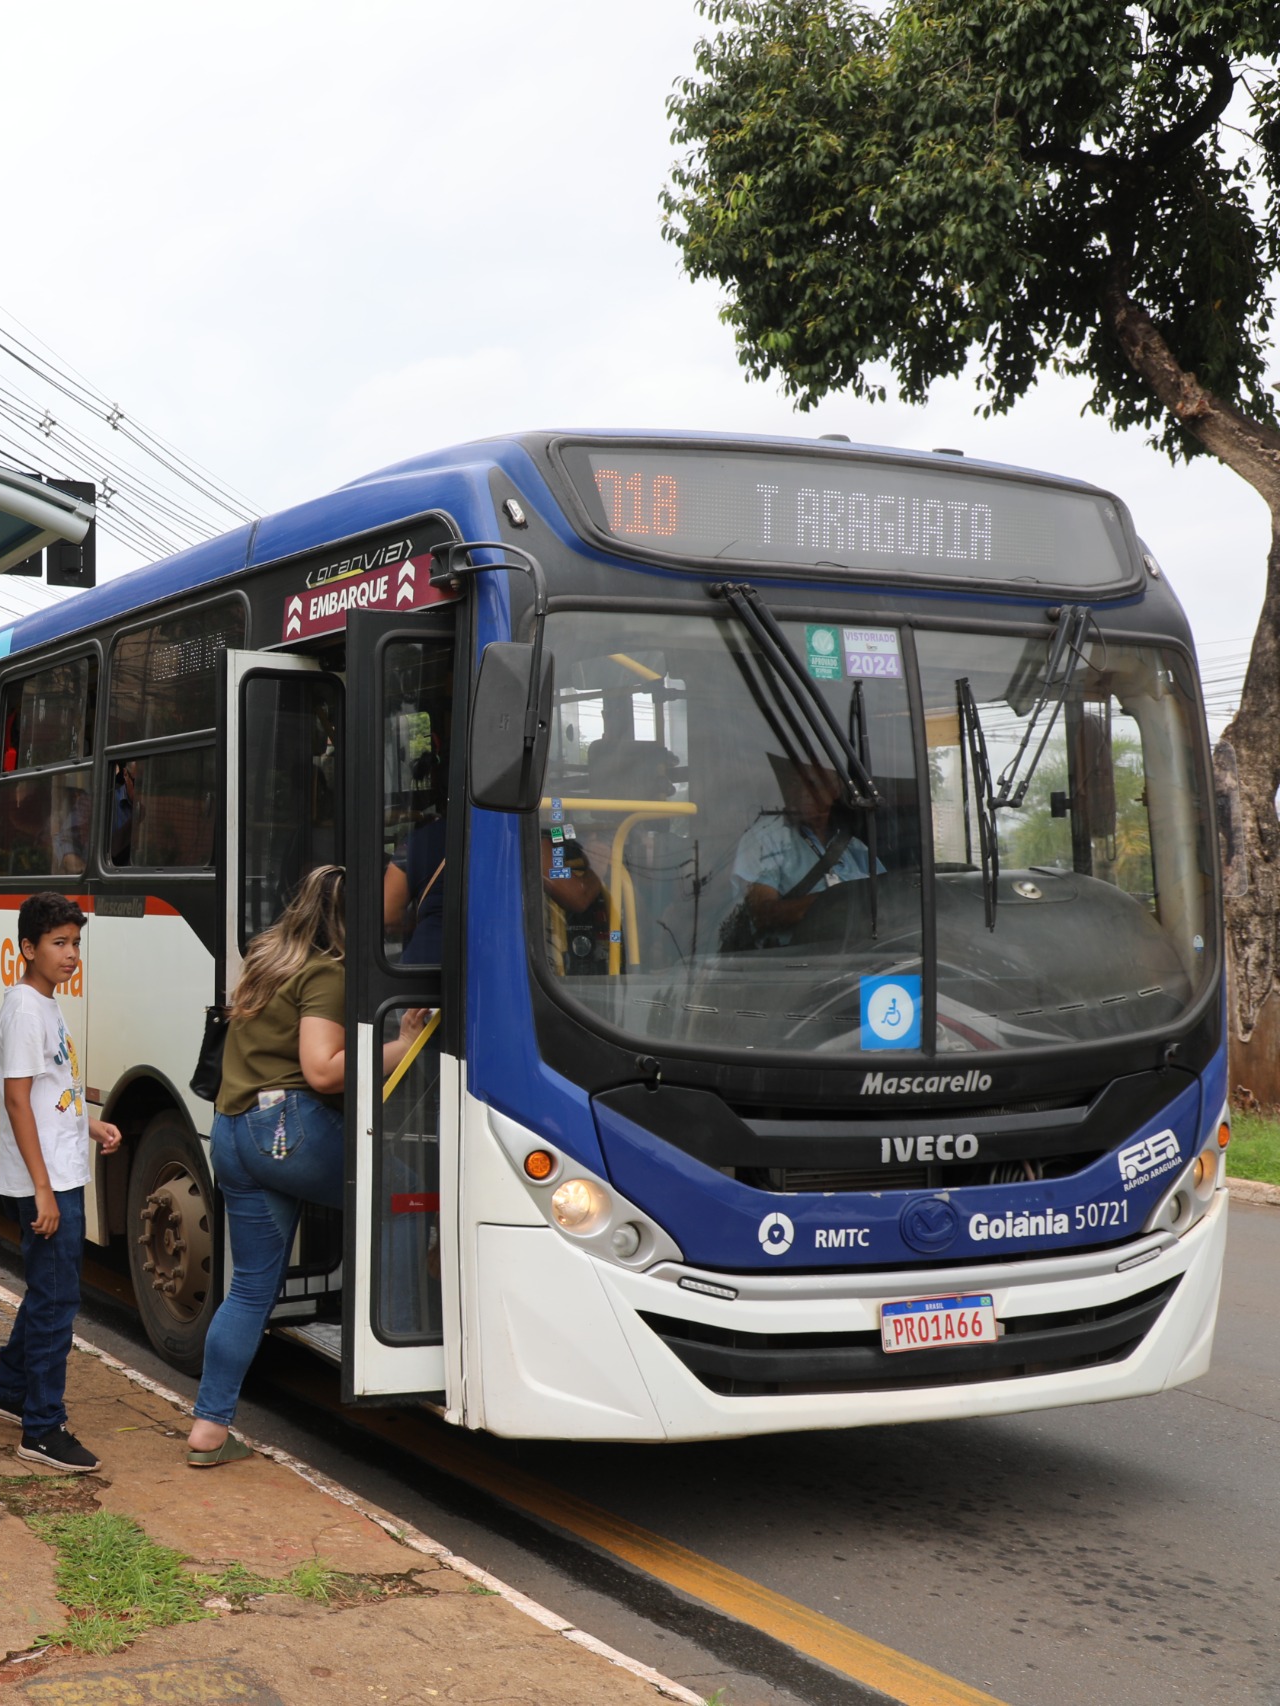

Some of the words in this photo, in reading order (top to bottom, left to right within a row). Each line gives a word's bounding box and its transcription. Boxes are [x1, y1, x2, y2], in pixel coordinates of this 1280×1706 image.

[756, 484, 779, 543] T
[796, 488, 992, 561] ARAGUAIA
[309, 575, 389, 621] EMBARQUE
[844, 631, 896, 643] VISTORIADO
[849, 654, 898, 675] 2024
[860, 1070, 992, 1095] Mascarello
[881, 1134, 978, 1163] IVECO
[1123, 1173, 1150, 1192] RÁPIDO
[1150, 1156, 1183, 1178] ARAGUAIA
[1075, 1199, 1128, 1230] 50721
[814, 1228, 870, 1248] RMTC
[925, 1302, 944, 1311] BRASIL
